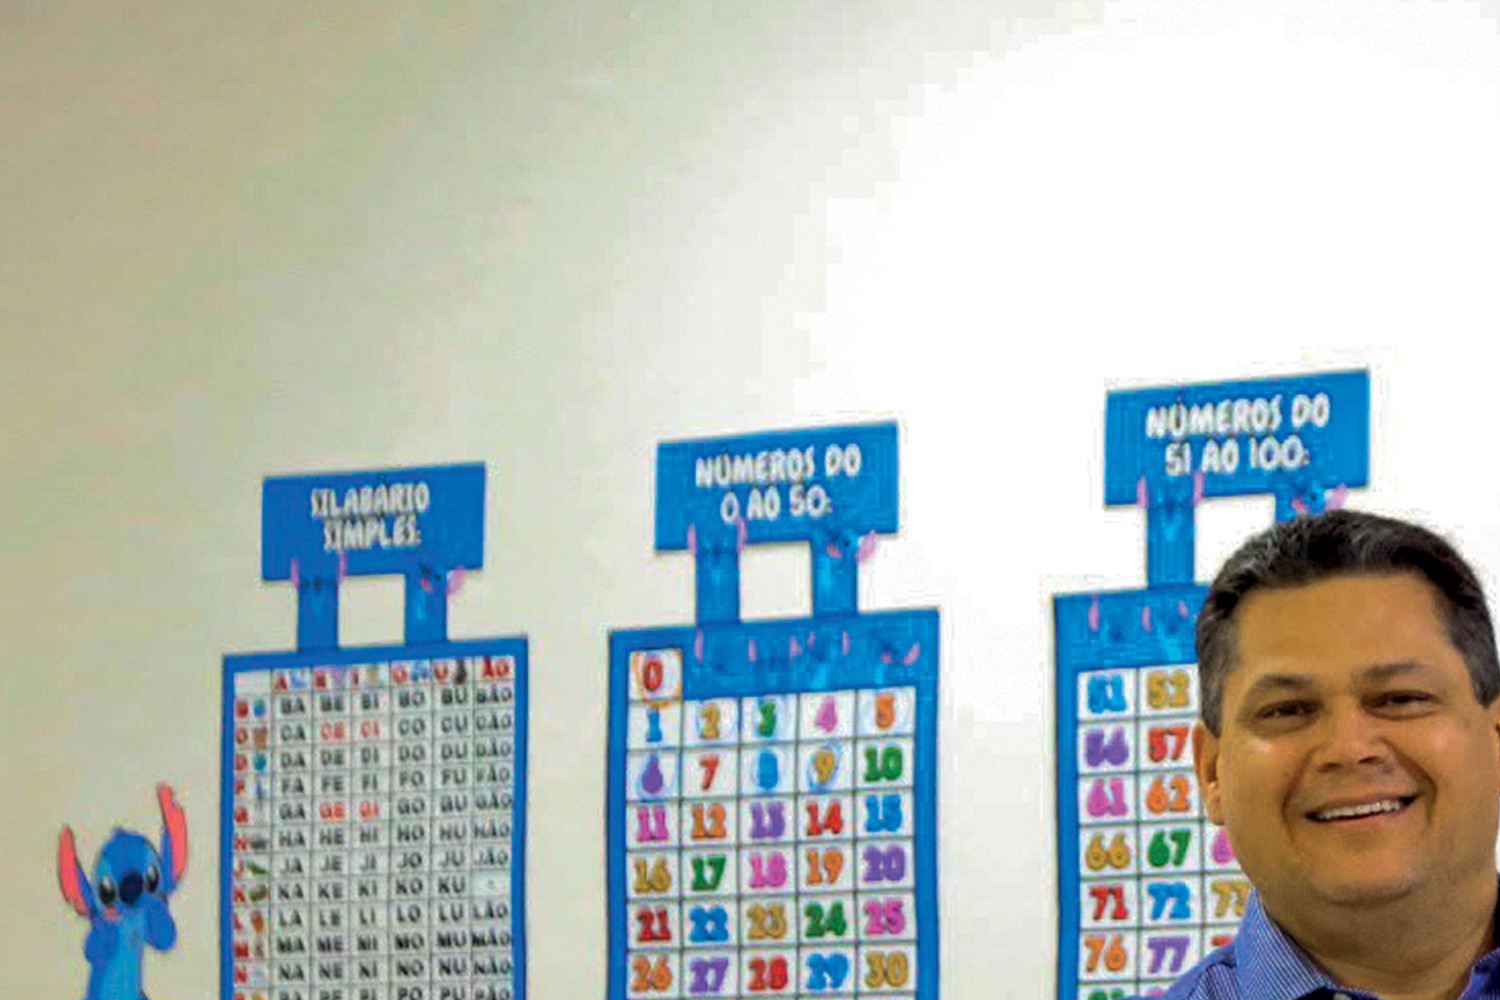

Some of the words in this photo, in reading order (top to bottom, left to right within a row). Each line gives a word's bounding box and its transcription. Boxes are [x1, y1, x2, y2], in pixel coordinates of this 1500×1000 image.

[1291, 392, 1330, 428] DO
[825, 443, 861, 477] DO
[1201, 437, 1239, 475] AO
[747, 484, 781, 521] AO
[644, 660, 664, 692] 0
[1088, 674, 1126, 713] 51
[1147, 670, 1190, 708] 52
[646, 710, 664, 743] 1
[699, 704, 721, 740] 2
[875, 695, 896, 731] 5
[1085, 726, 1129, 766] 56
[1148, 726, 1189, 762] 57
[699, 757, 720, 790] 7
[813, 749, 837, 784] 9
[864, 745, 904, 783] 10
[1087, 778, 1127, 817] 61
[1147, 775, 1190, 812] 62
[637, 808, 668, 843] 11
[692, 804, 726, 841] 12
[806, 802, 844, 837] 14
[1086, 832, 1131, 870] 66
[1147, 829, 1191, 867] 67
[635, 859, 671, 894] 16
[692, 854, 727, 891] 17
[751, 855, 787, 889] 18
[807, 851, 844, 886] 19
[865, 847, 905, 882] 20
[1089, 884, 1128, 920] 71
[1147, 882, 1191, 920] 72
[637, 909, 672, 944] 21
[688, 905, 730, 943] 22
[748, 905, 786, 940] 23
[806, 902, 848, 939] 24
[866, 900, 905, 935] 25
[633, 958, 672, 993] 26
[691, 959, 729, 993] 27
[749, 956, 789, 992] 28
[806, 952, 851, 992] 29
[866, 953, 909, 988] 30
[1084, 935, 1126, 971] 76
[1147, 936, 1190, 973] 77
